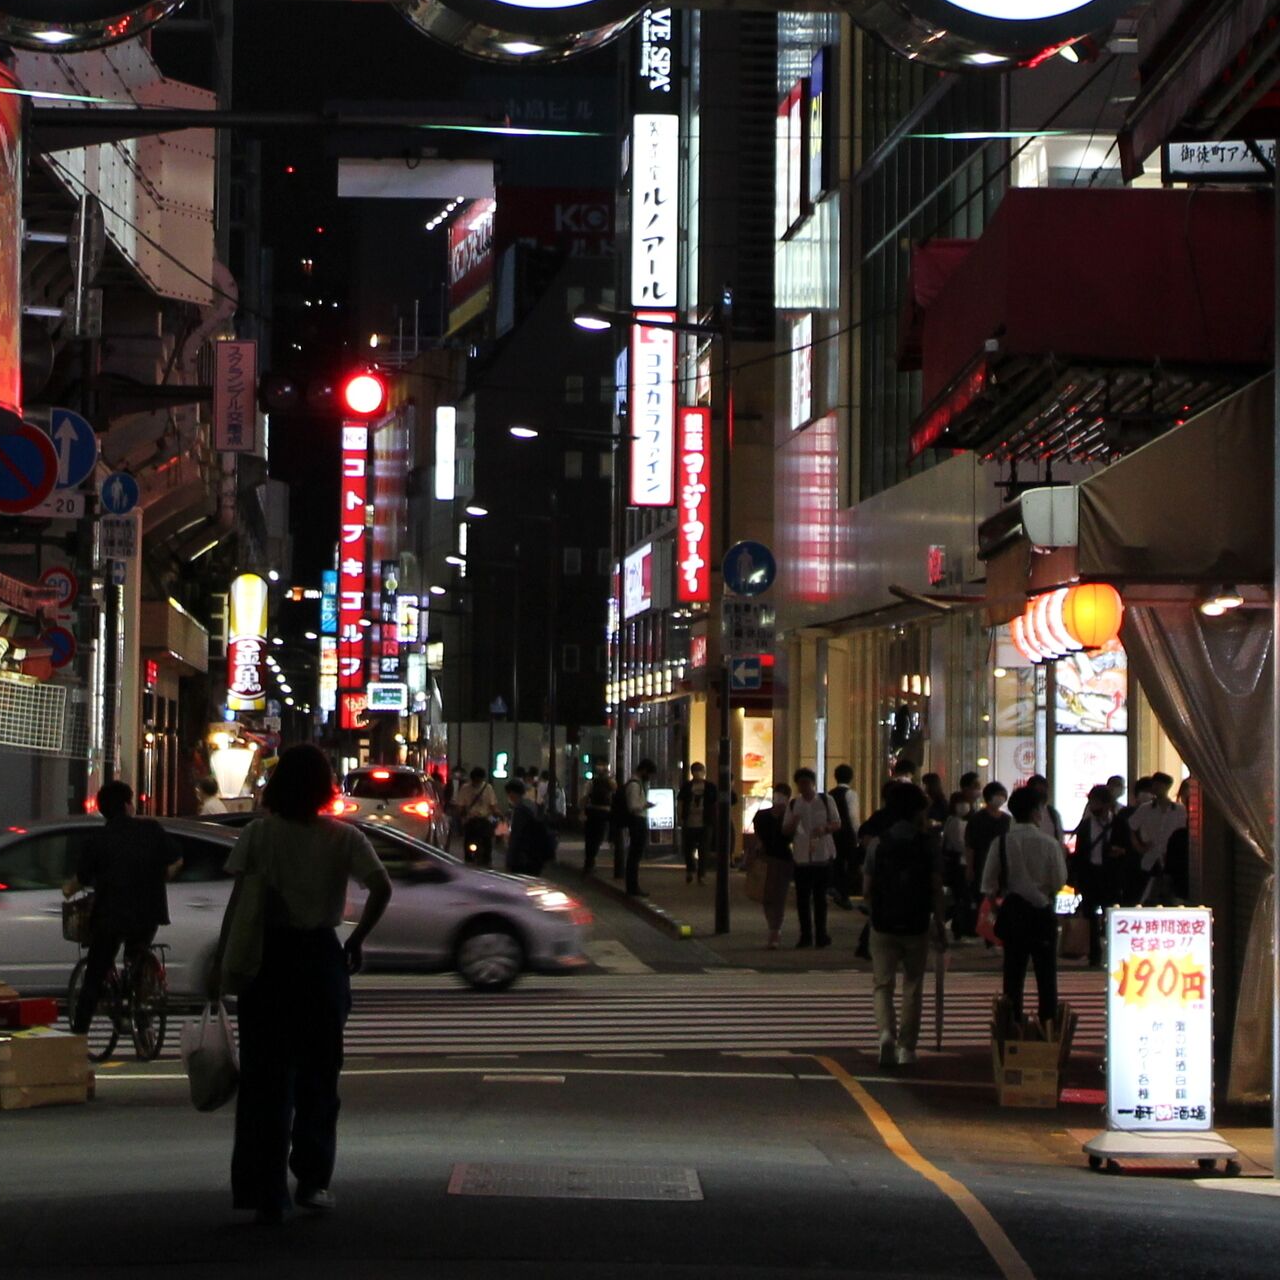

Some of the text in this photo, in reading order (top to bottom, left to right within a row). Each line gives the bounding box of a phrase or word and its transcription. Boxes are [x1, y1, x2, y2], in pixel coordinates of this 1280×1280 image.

[649, 46, 671, 91] SPA
[645, 352, 662, 494] ココカラファイン
[340, 458, 366, 676] コトブキゴルフ
[232, 639, 262, 694] 金魚
[381, 657, 400, 673] 2F
[1116, 919, 1206, 935] 24時間激安
[1116, 958, 1207, 1001] 190円
